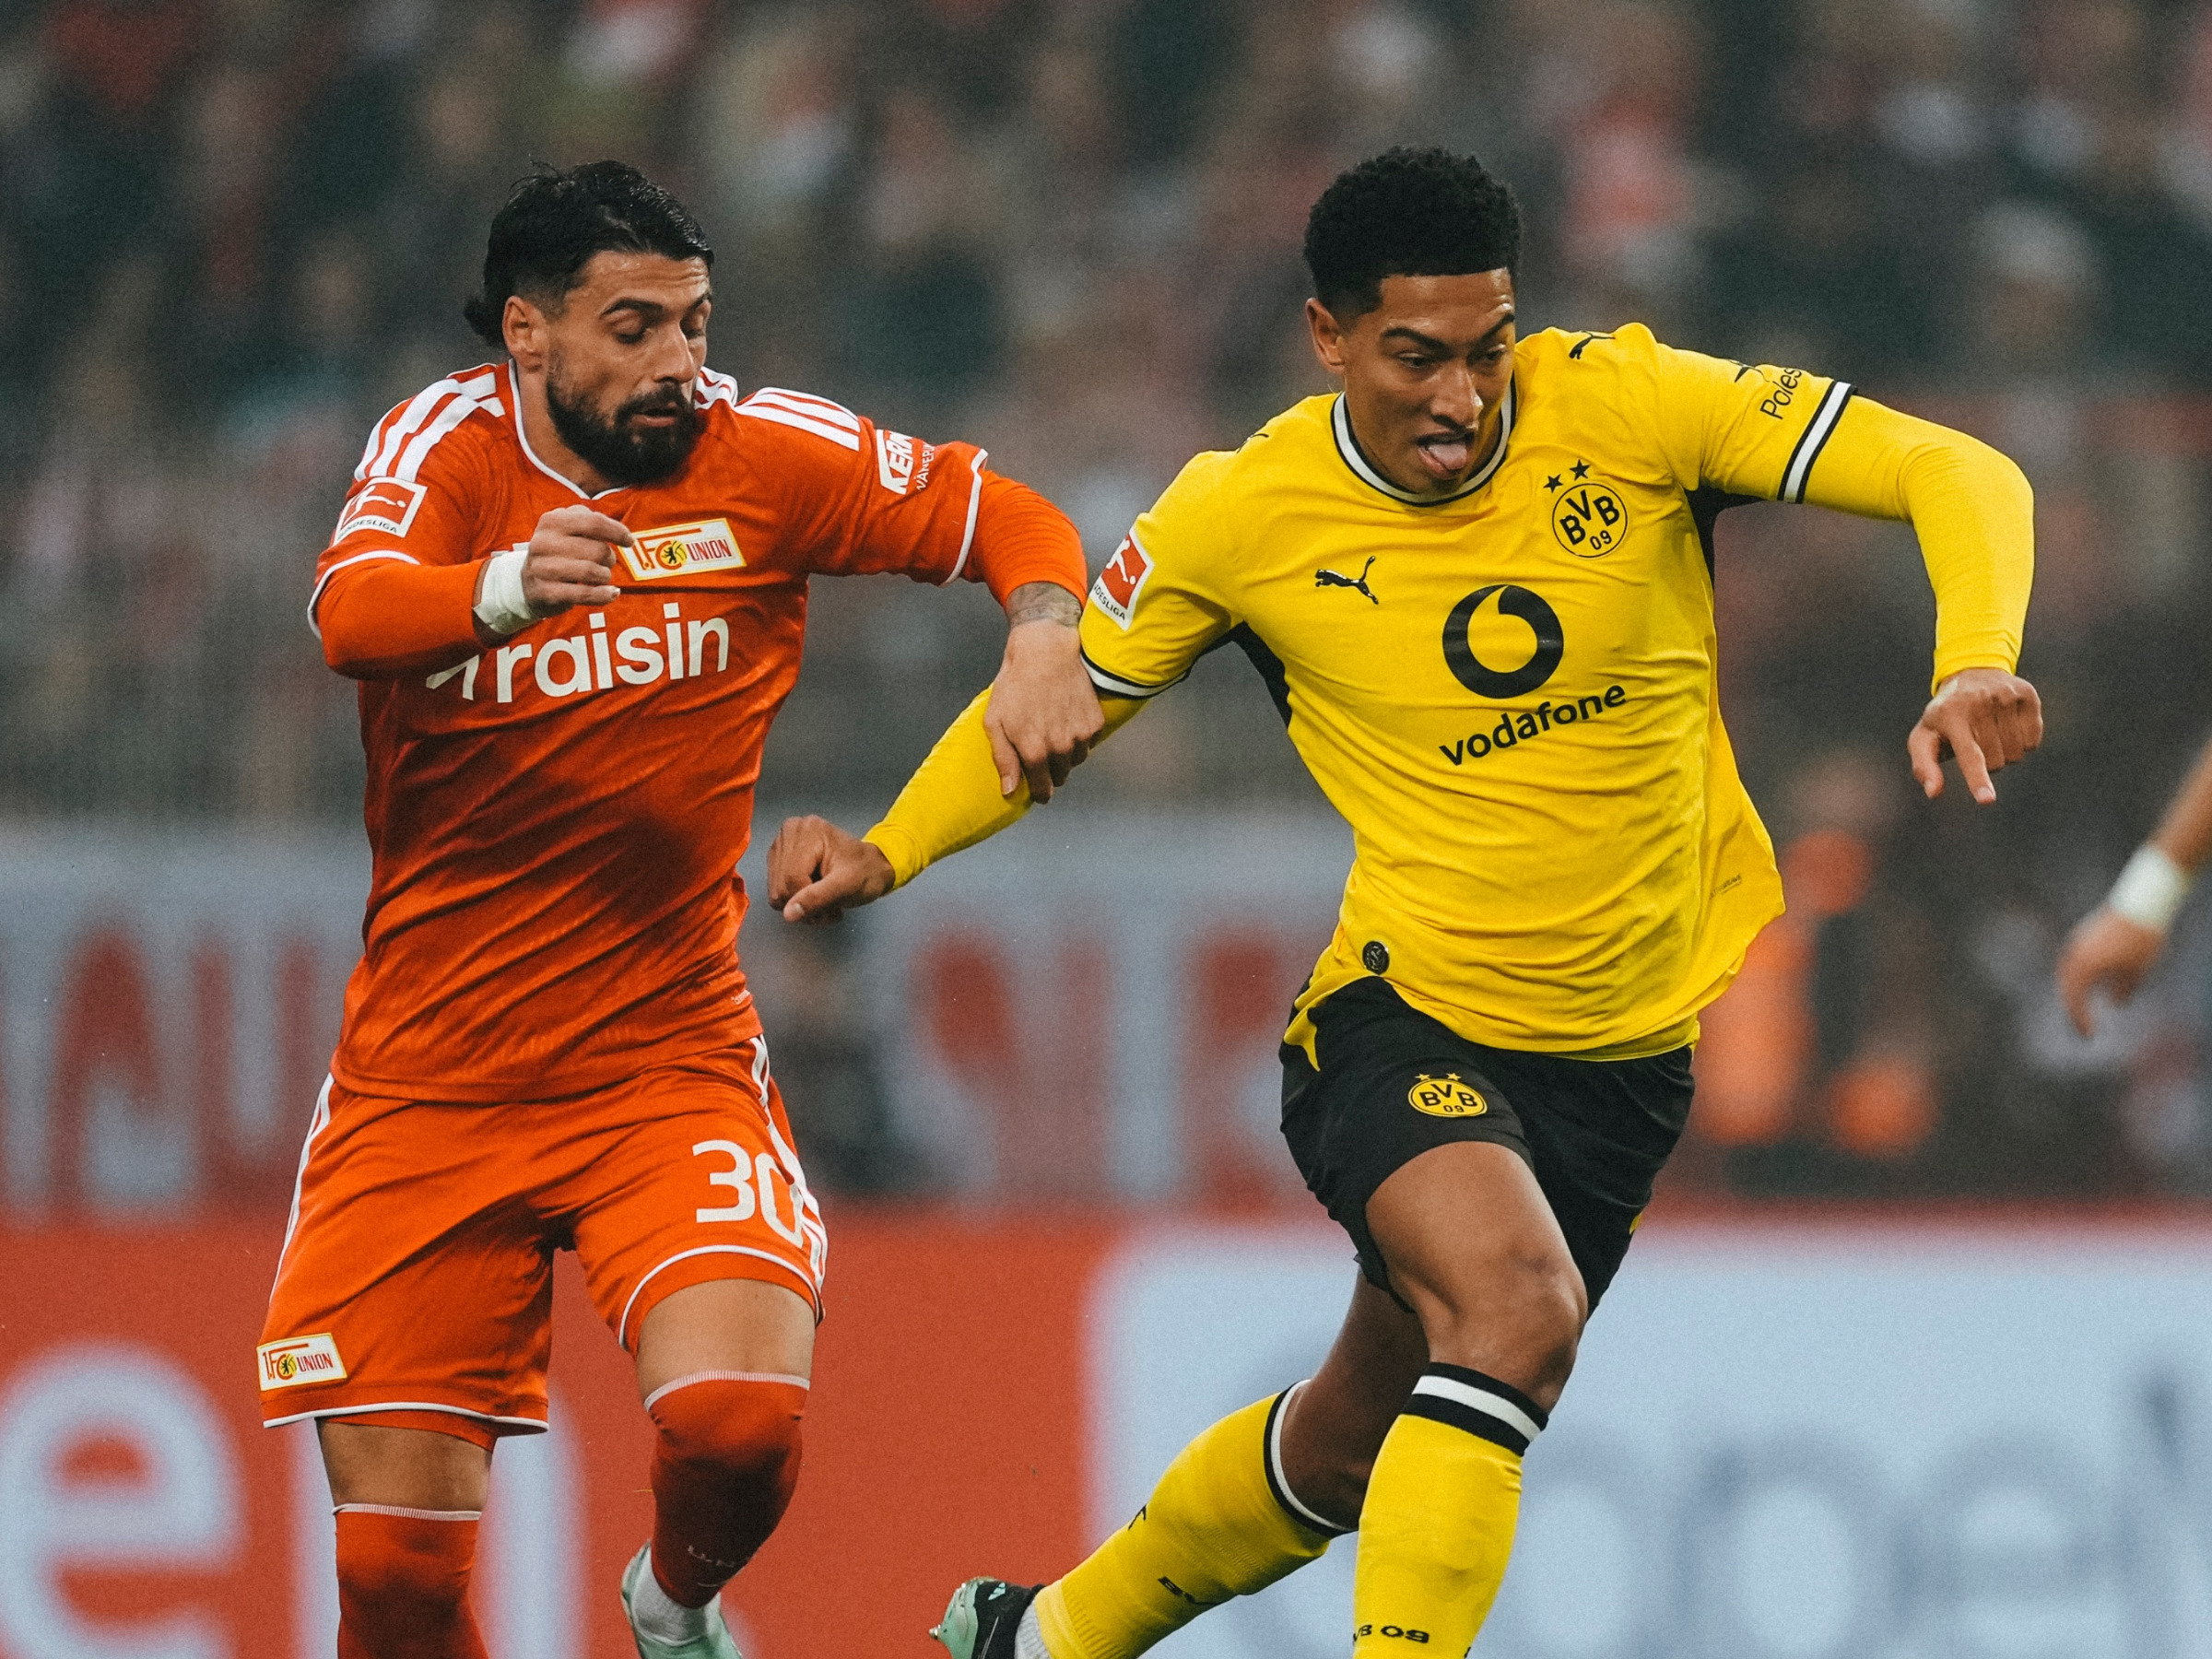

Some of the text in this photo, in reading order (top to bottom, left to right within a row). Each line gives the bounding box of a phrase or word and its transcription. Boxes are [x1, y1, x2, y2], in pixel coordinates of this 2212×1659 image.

[1559, 488, 1620, 546] BVB
[686, 538, 733, 561] UNION
[1589, 529, 1613, 550] 09
[496, 601, 730, 704] raisin
[1438, 684, 1628, 767] vodafone
[1418, 1083, 1478, 1107] BVB
[691, 1138, 805, 1250] 30
[296, 1351, 334, 1373] UNION
